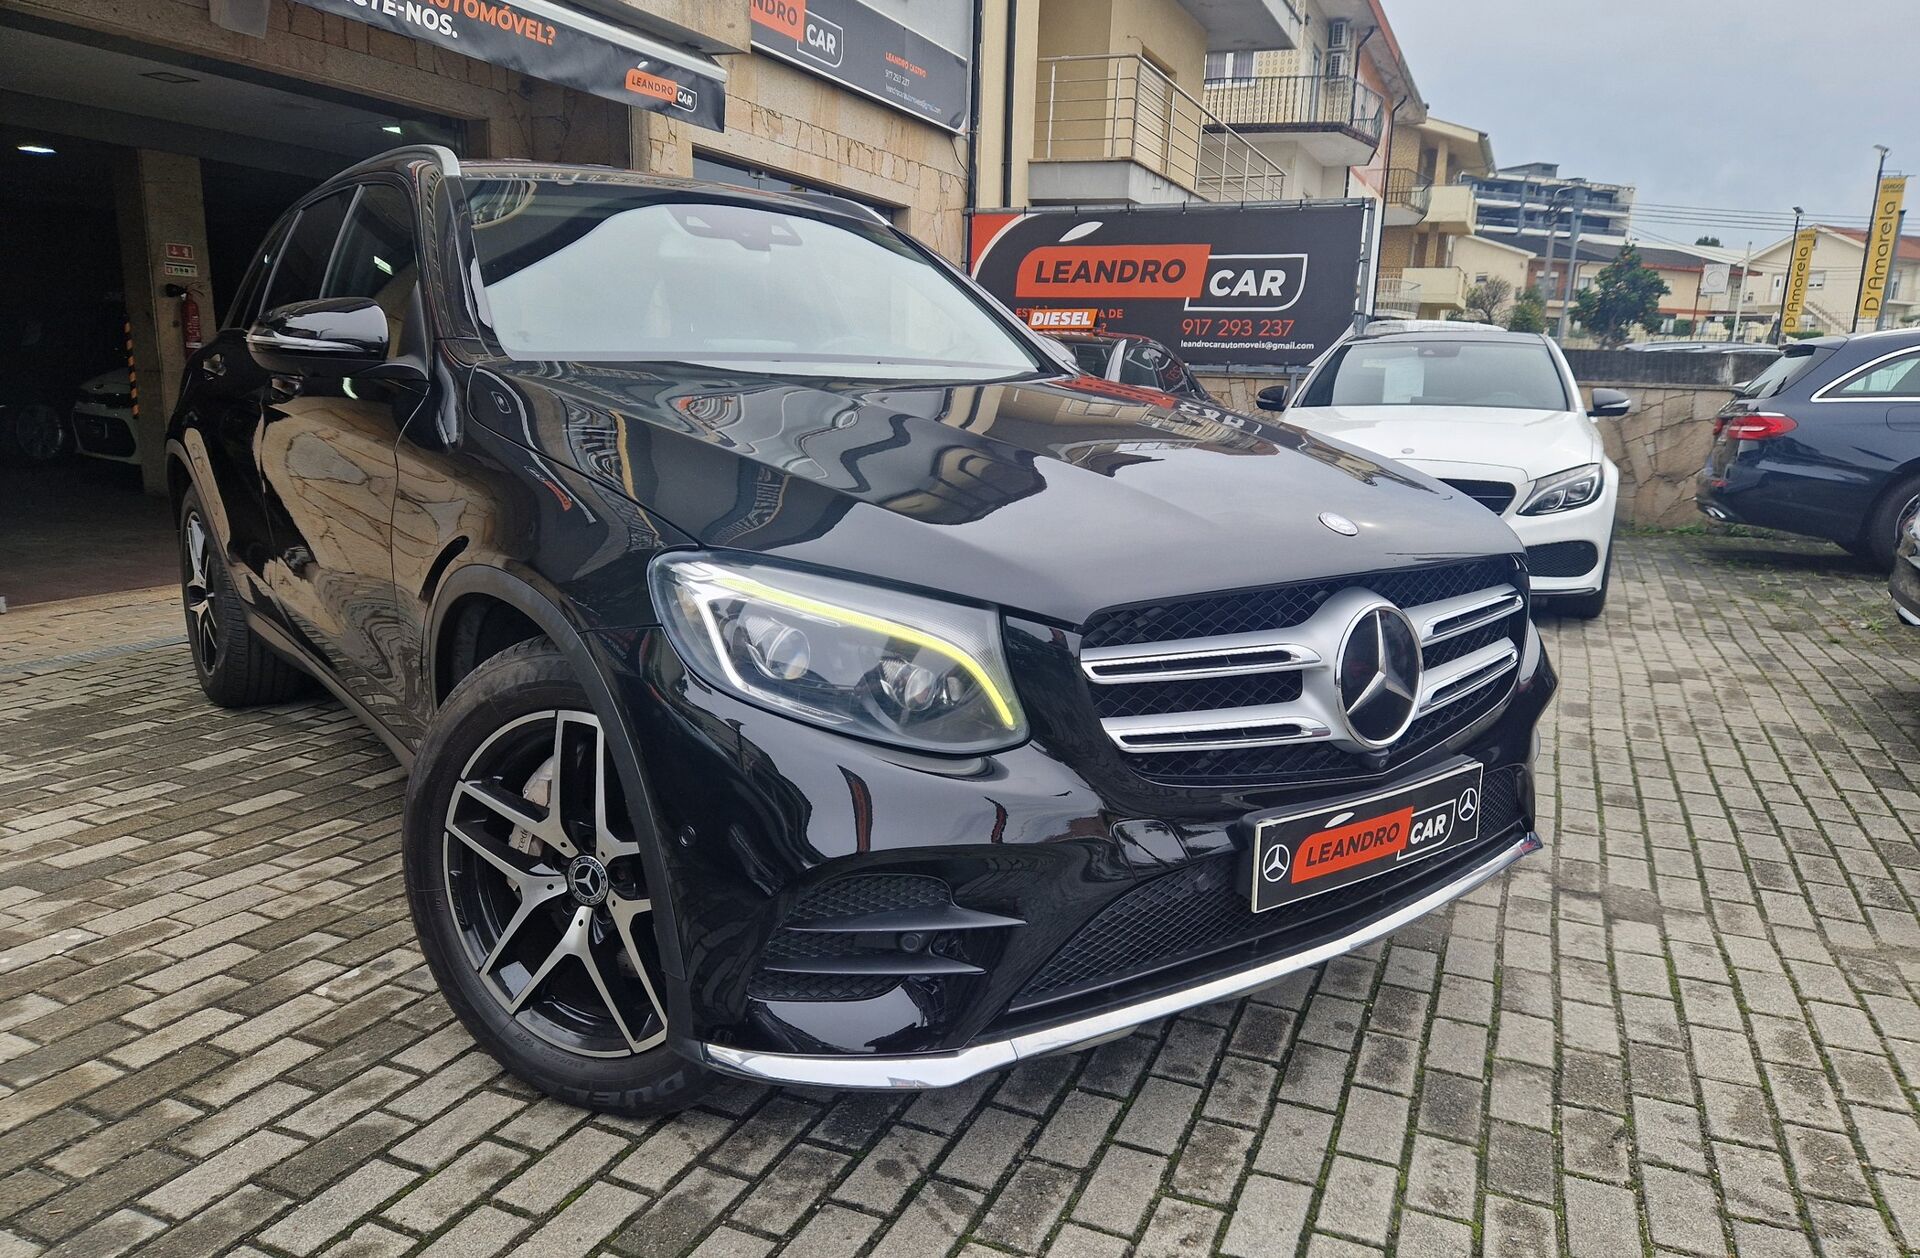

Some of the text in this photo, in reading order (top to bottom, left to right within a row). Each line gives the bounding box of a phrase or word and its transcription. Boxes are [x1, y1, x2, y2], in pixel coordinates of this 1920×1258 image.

[428, 0, 556, 46] TOMÓVEL?
[806, 24, 836, 57] CAR
[631, 74, 693, 107] LEANDRO CAR
[1863, 200, 1896, 311] D'Amarela
[1035, 259, 1287, 297] LEANDRO CAR
[1784, 246, 1809, 328] D'Amarela
[1031, 312, 1091, 326] DIESEL
[1109, 309, 1124, 319] DE
[1182, 319, 1295, 337] 917 293 237
[1306, 813, 1447, 867] LEANDRO CAR
